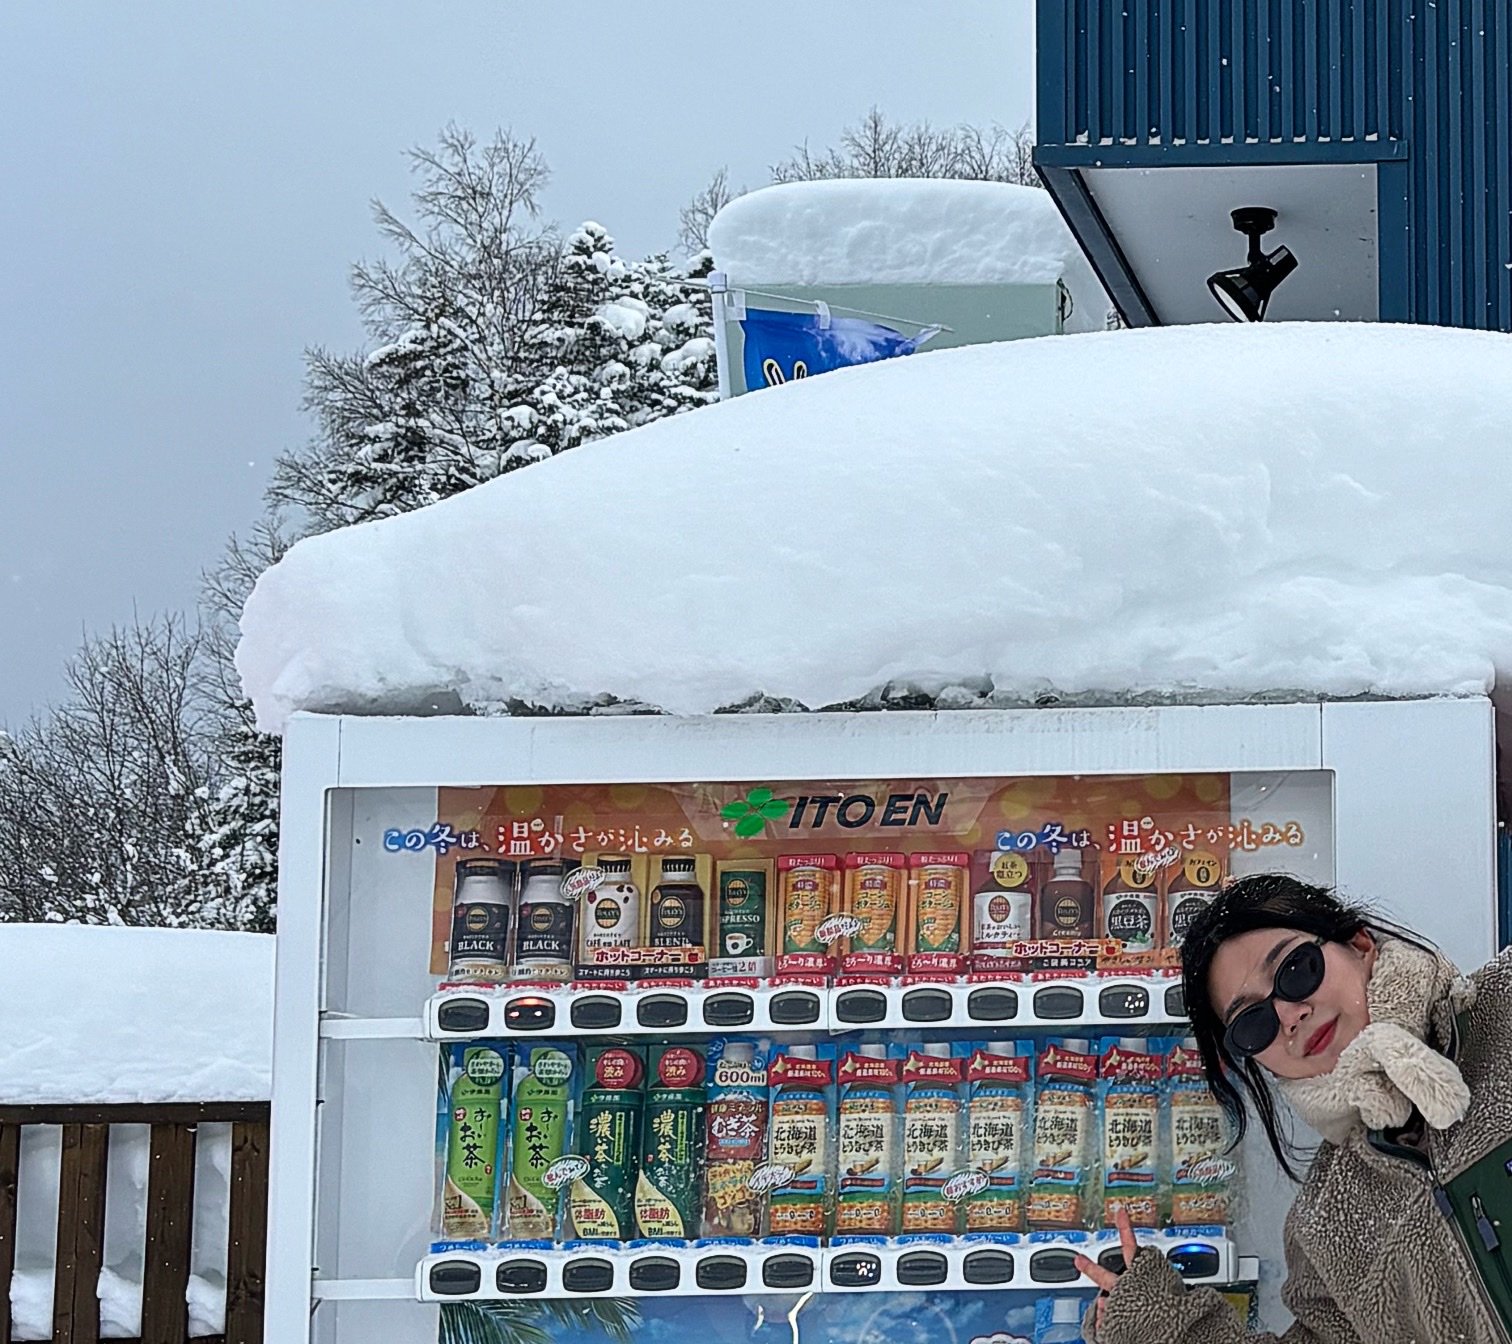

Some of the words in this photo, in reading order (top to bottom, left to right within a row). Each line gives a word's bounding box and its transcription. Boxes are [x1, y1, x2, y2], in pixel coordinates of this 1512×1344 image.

[789, 795, 875, 829] ITO
[880, 793, 948, 827] EN
[1110, 915, 1149, 929] 黒豆茶
[457, 941, 494, 951] BLACK
[522, 941, 560, 951] BLACK
[1014, 942, 1100, 956] ホットコーナー
[594, 948, 682, 964] ホットコーナー
[719, 1071, 765, 1084] 600ml
[711, 1115, 759, 1136] むぎ茶
[590, 1110, 614, 1163] 濃い茶
[652, 1109, 676, 1161] 濃い茶
[460, 1122, 486, 1169] お茶
[525, 1123, 552, 1169] お茶
